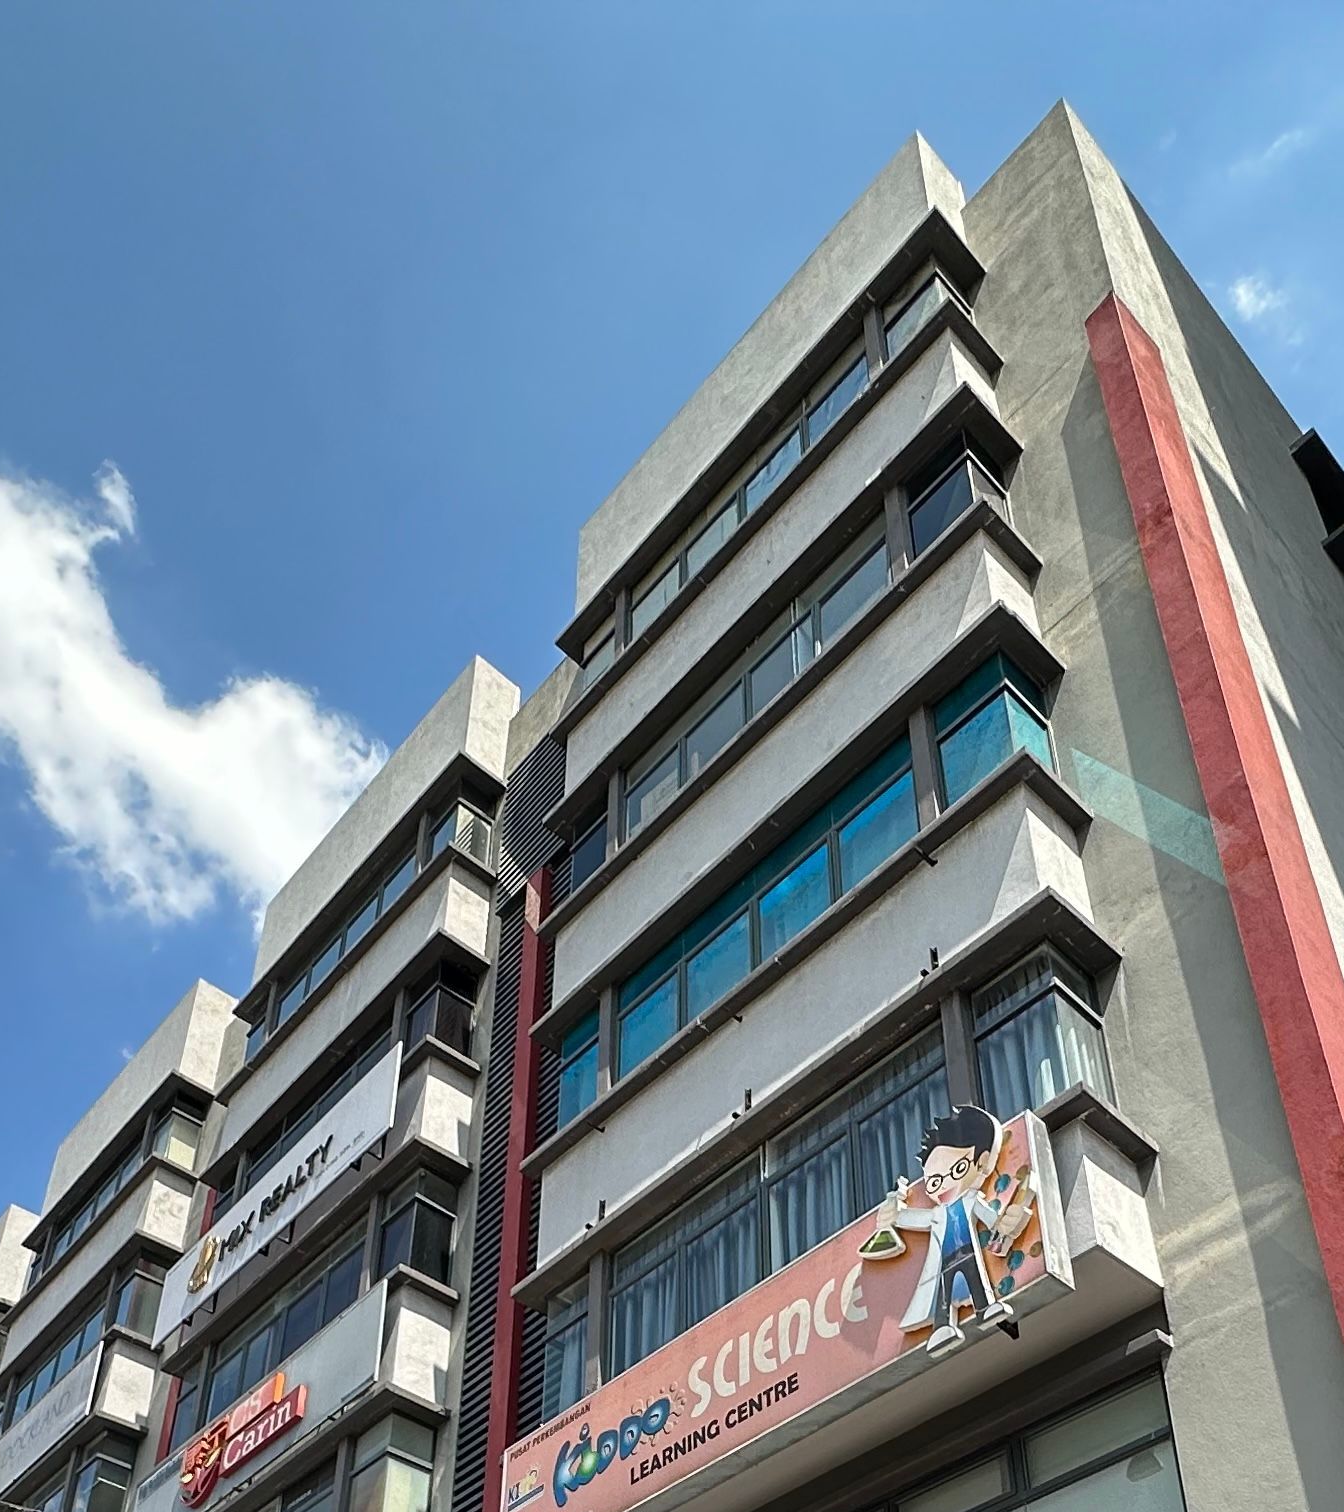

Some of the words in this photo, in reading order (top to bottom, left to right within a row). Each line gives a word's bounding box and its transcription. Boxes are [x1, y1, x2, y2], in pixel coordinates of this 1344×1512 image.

[259, 1134, 333, 1223] REALTY
[687, 1262, 869, 1419] SCIENCE
[222, 1400, 292, 1471] Carin
[629, 1420, 720, 1485] LEARNING
[724, 1373, 800, 1430] CENTRE
